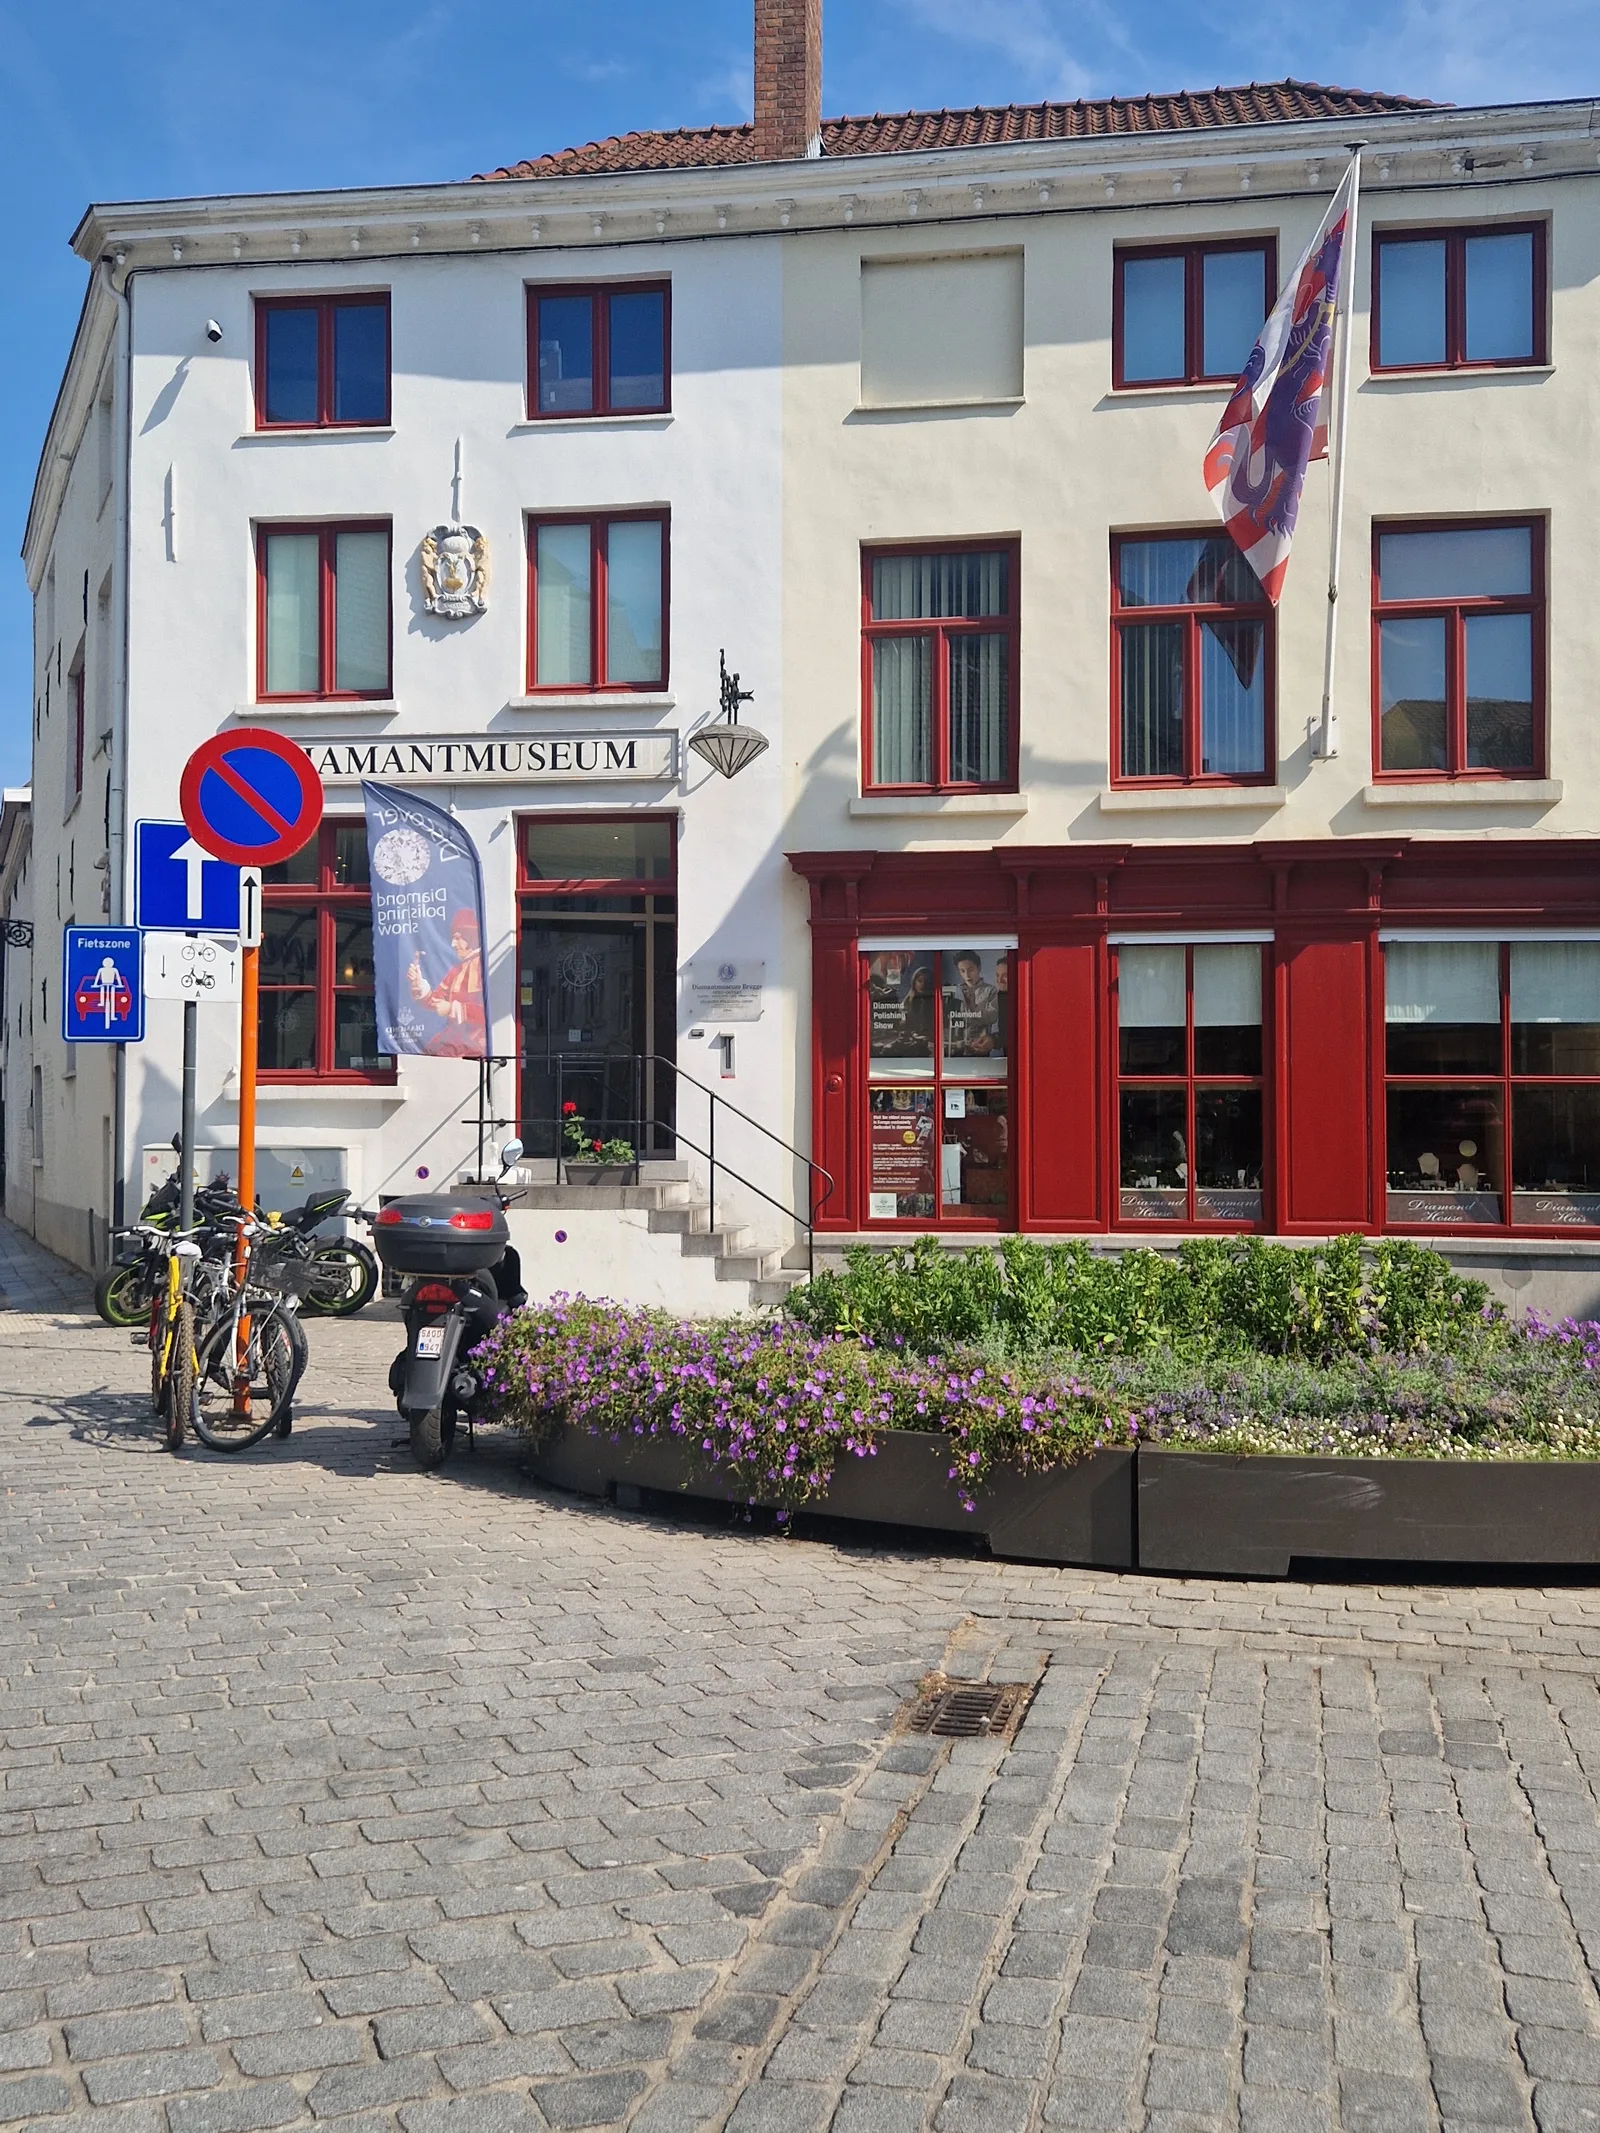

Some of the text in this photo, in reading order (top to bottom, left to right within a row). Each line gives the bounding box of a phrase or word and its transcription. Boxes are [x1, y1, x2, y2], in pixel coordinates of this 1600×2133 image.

[77, 937, 131, 949] Fietszone
[195, 990, 201, 998] A
[873, 1002, 904, 1010] Diamond
[873, 1011, 906, 1021] Polishing
[949, 1020, 965, 1028] LAB
[1121, 1195, 1187, 1207] Diamond
[1408, 1199, 1477, 1212] Diamond
[1133, 1206, 1173, 1218] House
[1212, 1207, 1245, 1218] Huis
[1420, 1211, 1463, 1223] House
[1551, 1211, 1587, 1223] Huis
[424, 1343, 440, 1352] 947
